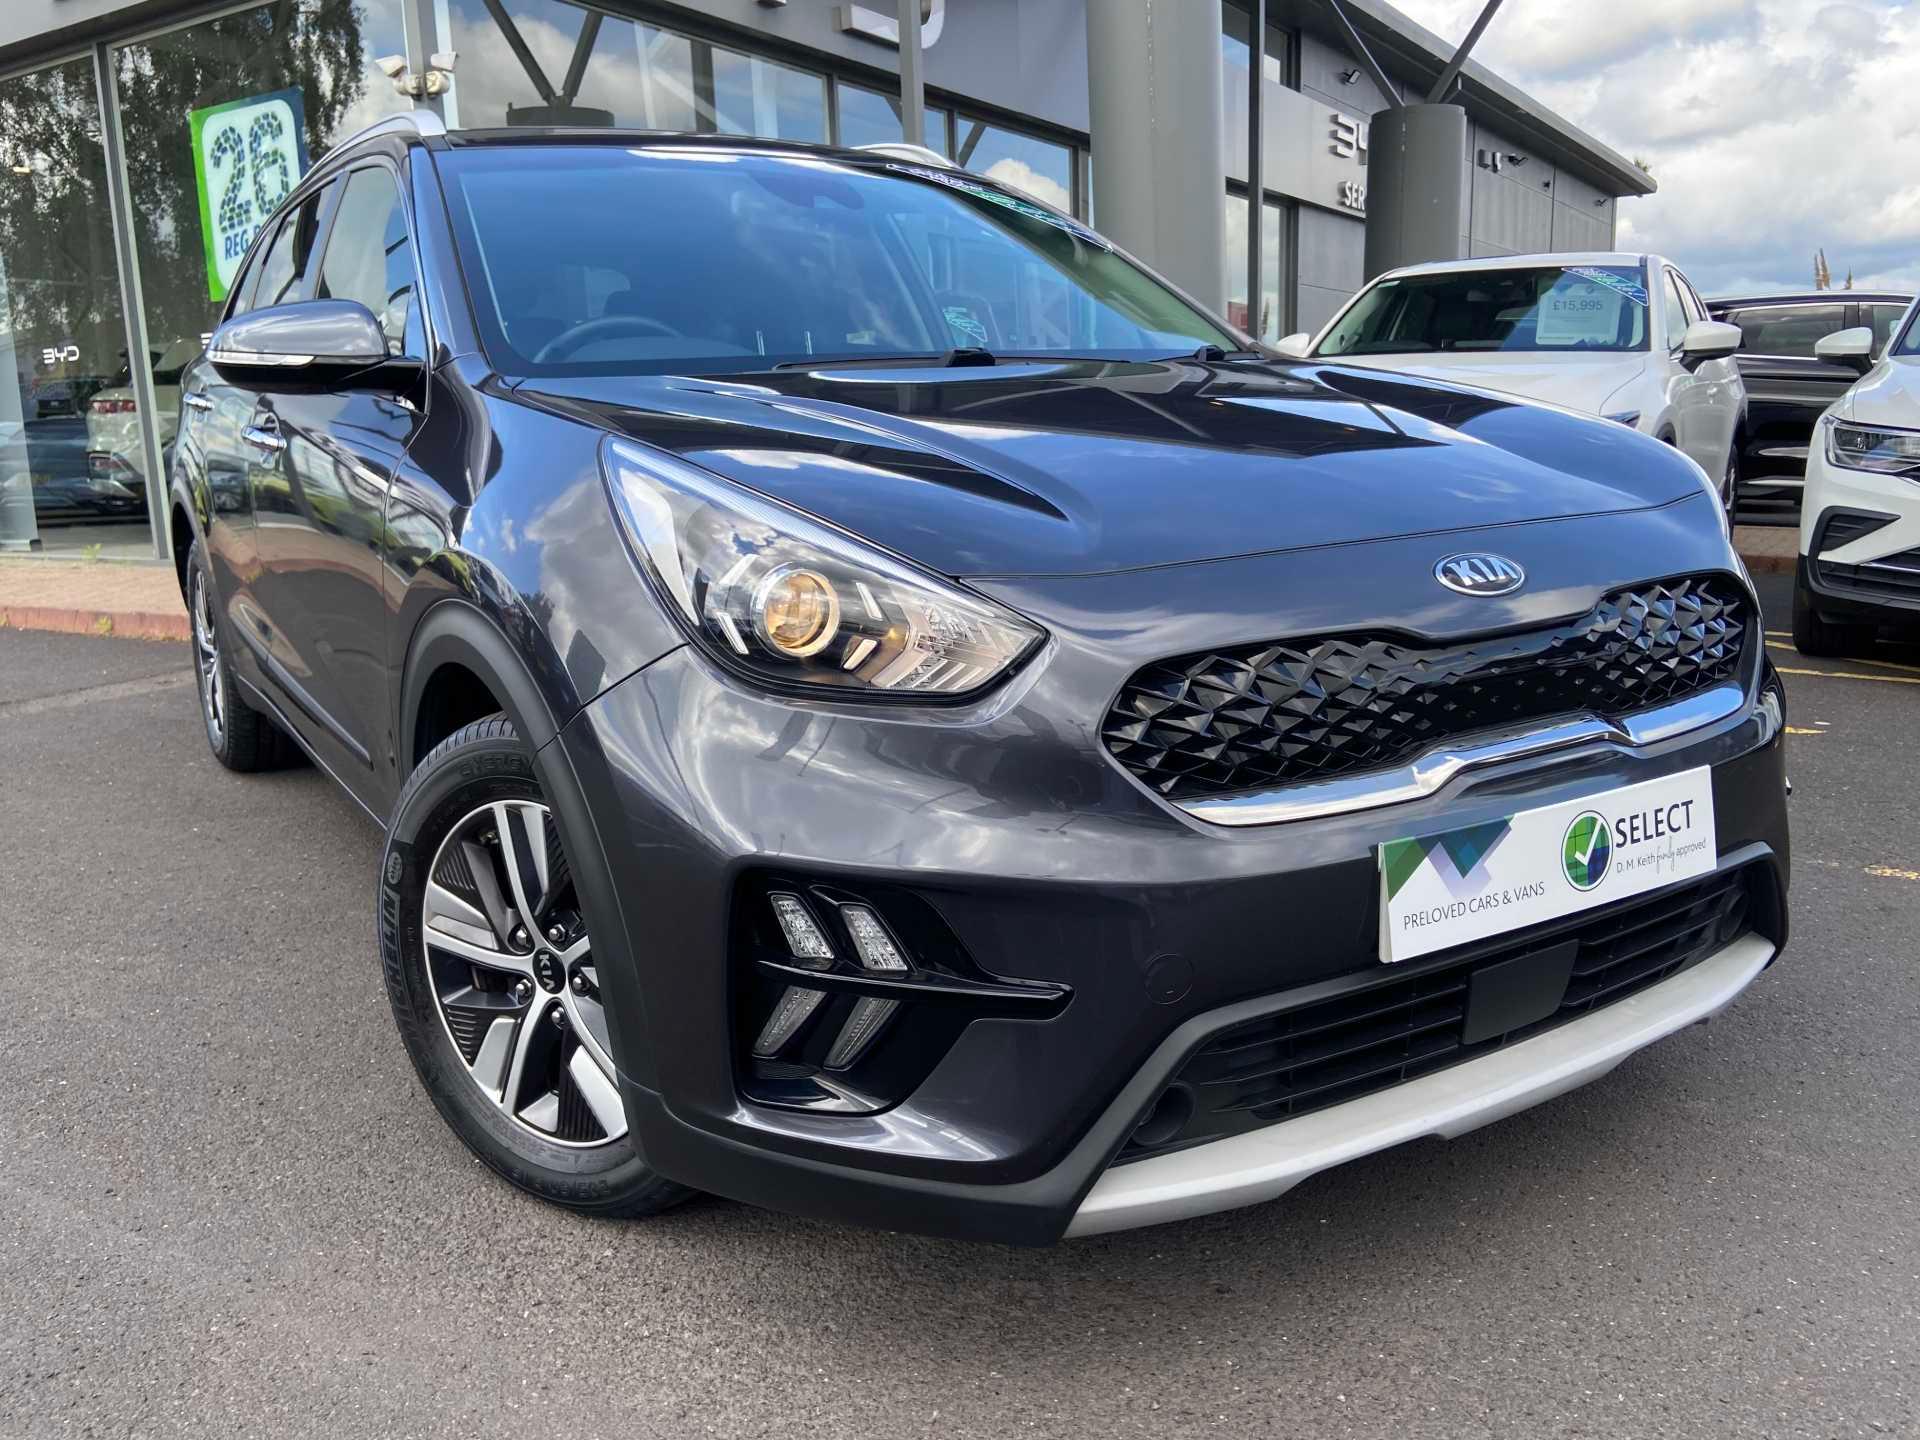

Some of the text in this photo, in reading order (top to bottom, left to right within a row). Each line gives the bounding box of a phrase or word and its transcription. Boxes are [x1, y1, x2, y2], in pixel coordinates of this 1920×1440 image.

[210, 111, 290, 234] 26
[1343, 180, 1366, 211] SER
[223, 228, 250, 261] REG
[42, 345, 80, 364] BYD
[1444, 556, 1520, 587] KIA
[1615, 800, 1694, 848] SELECT
[1637, 852, 1656, 868] Keith
[1676, 837, 1706, 859] approved
[1404, 881, 1545, 930] PRELOVED CARS & VANS
[539, 954, 556, 990] KIA
